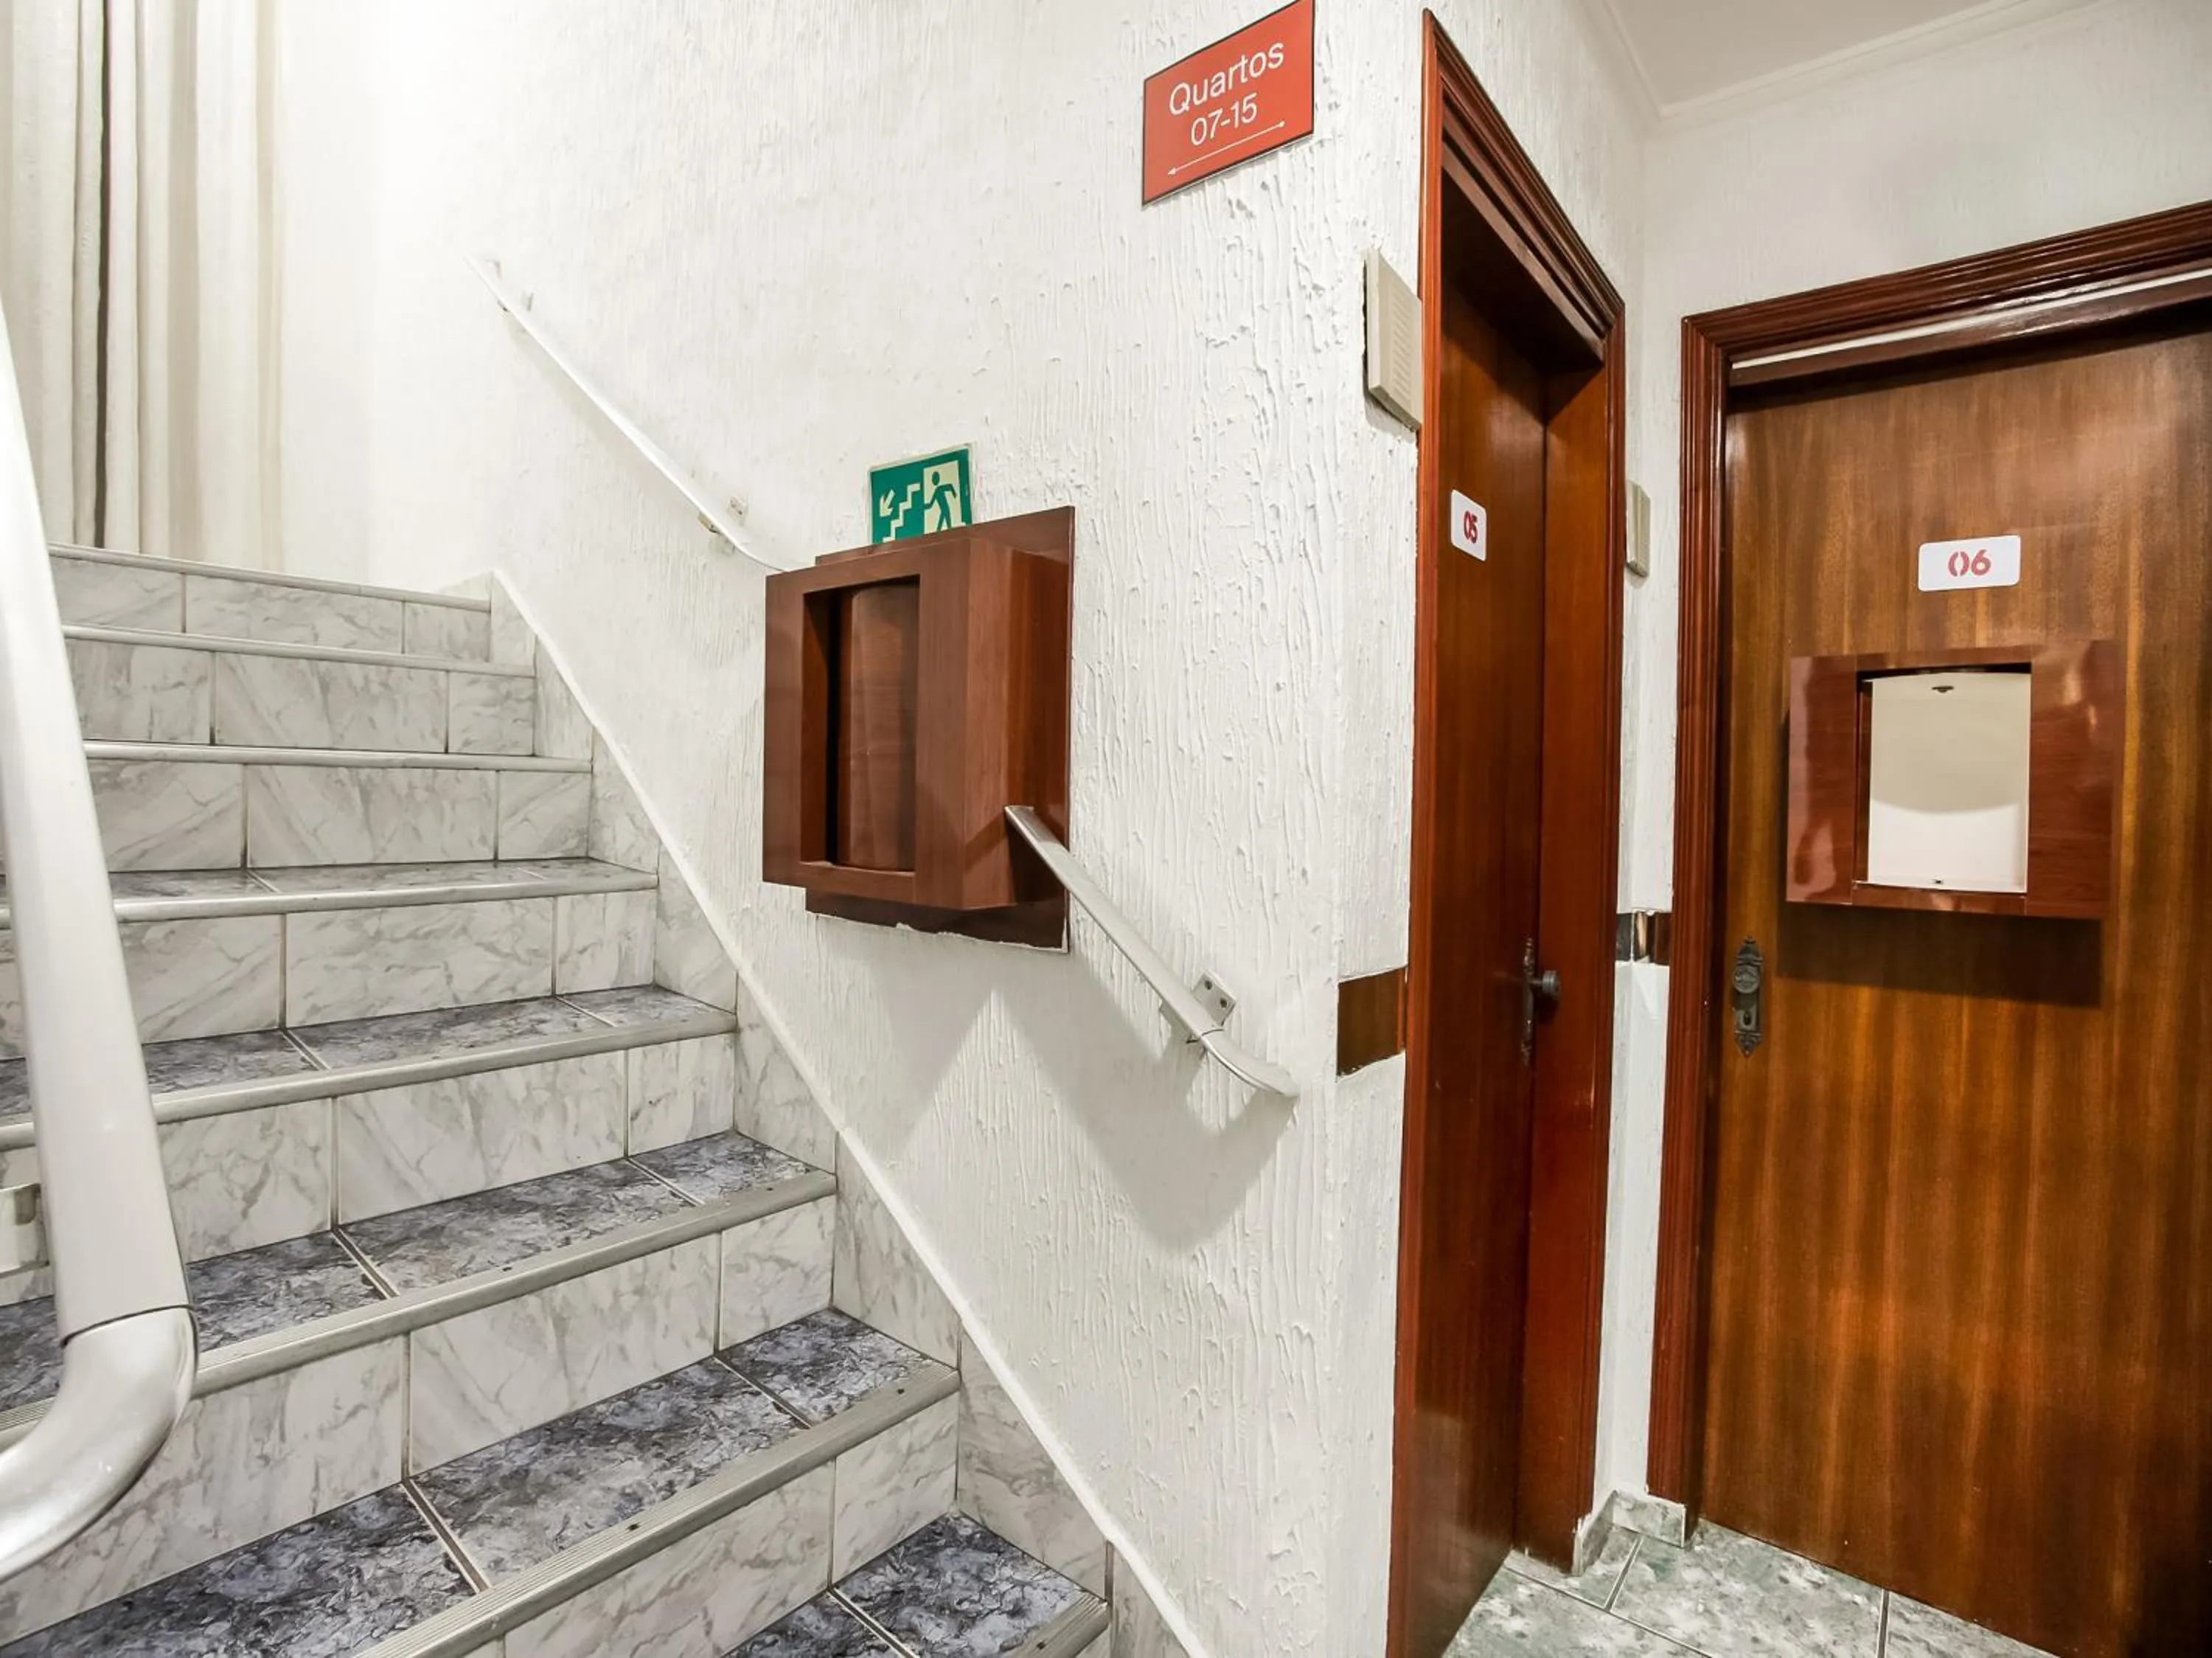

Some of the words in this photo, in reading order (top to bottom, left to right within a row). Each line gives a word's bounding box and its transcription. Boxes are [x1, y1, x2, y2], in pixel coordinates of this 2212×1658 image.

[1169, 42, 1284, 115] Quartos
[1191, 93, 1257, 145] 07-15
[1464, 510, 1478, 544] 05
[1948, 549, 1992, 577] 06
